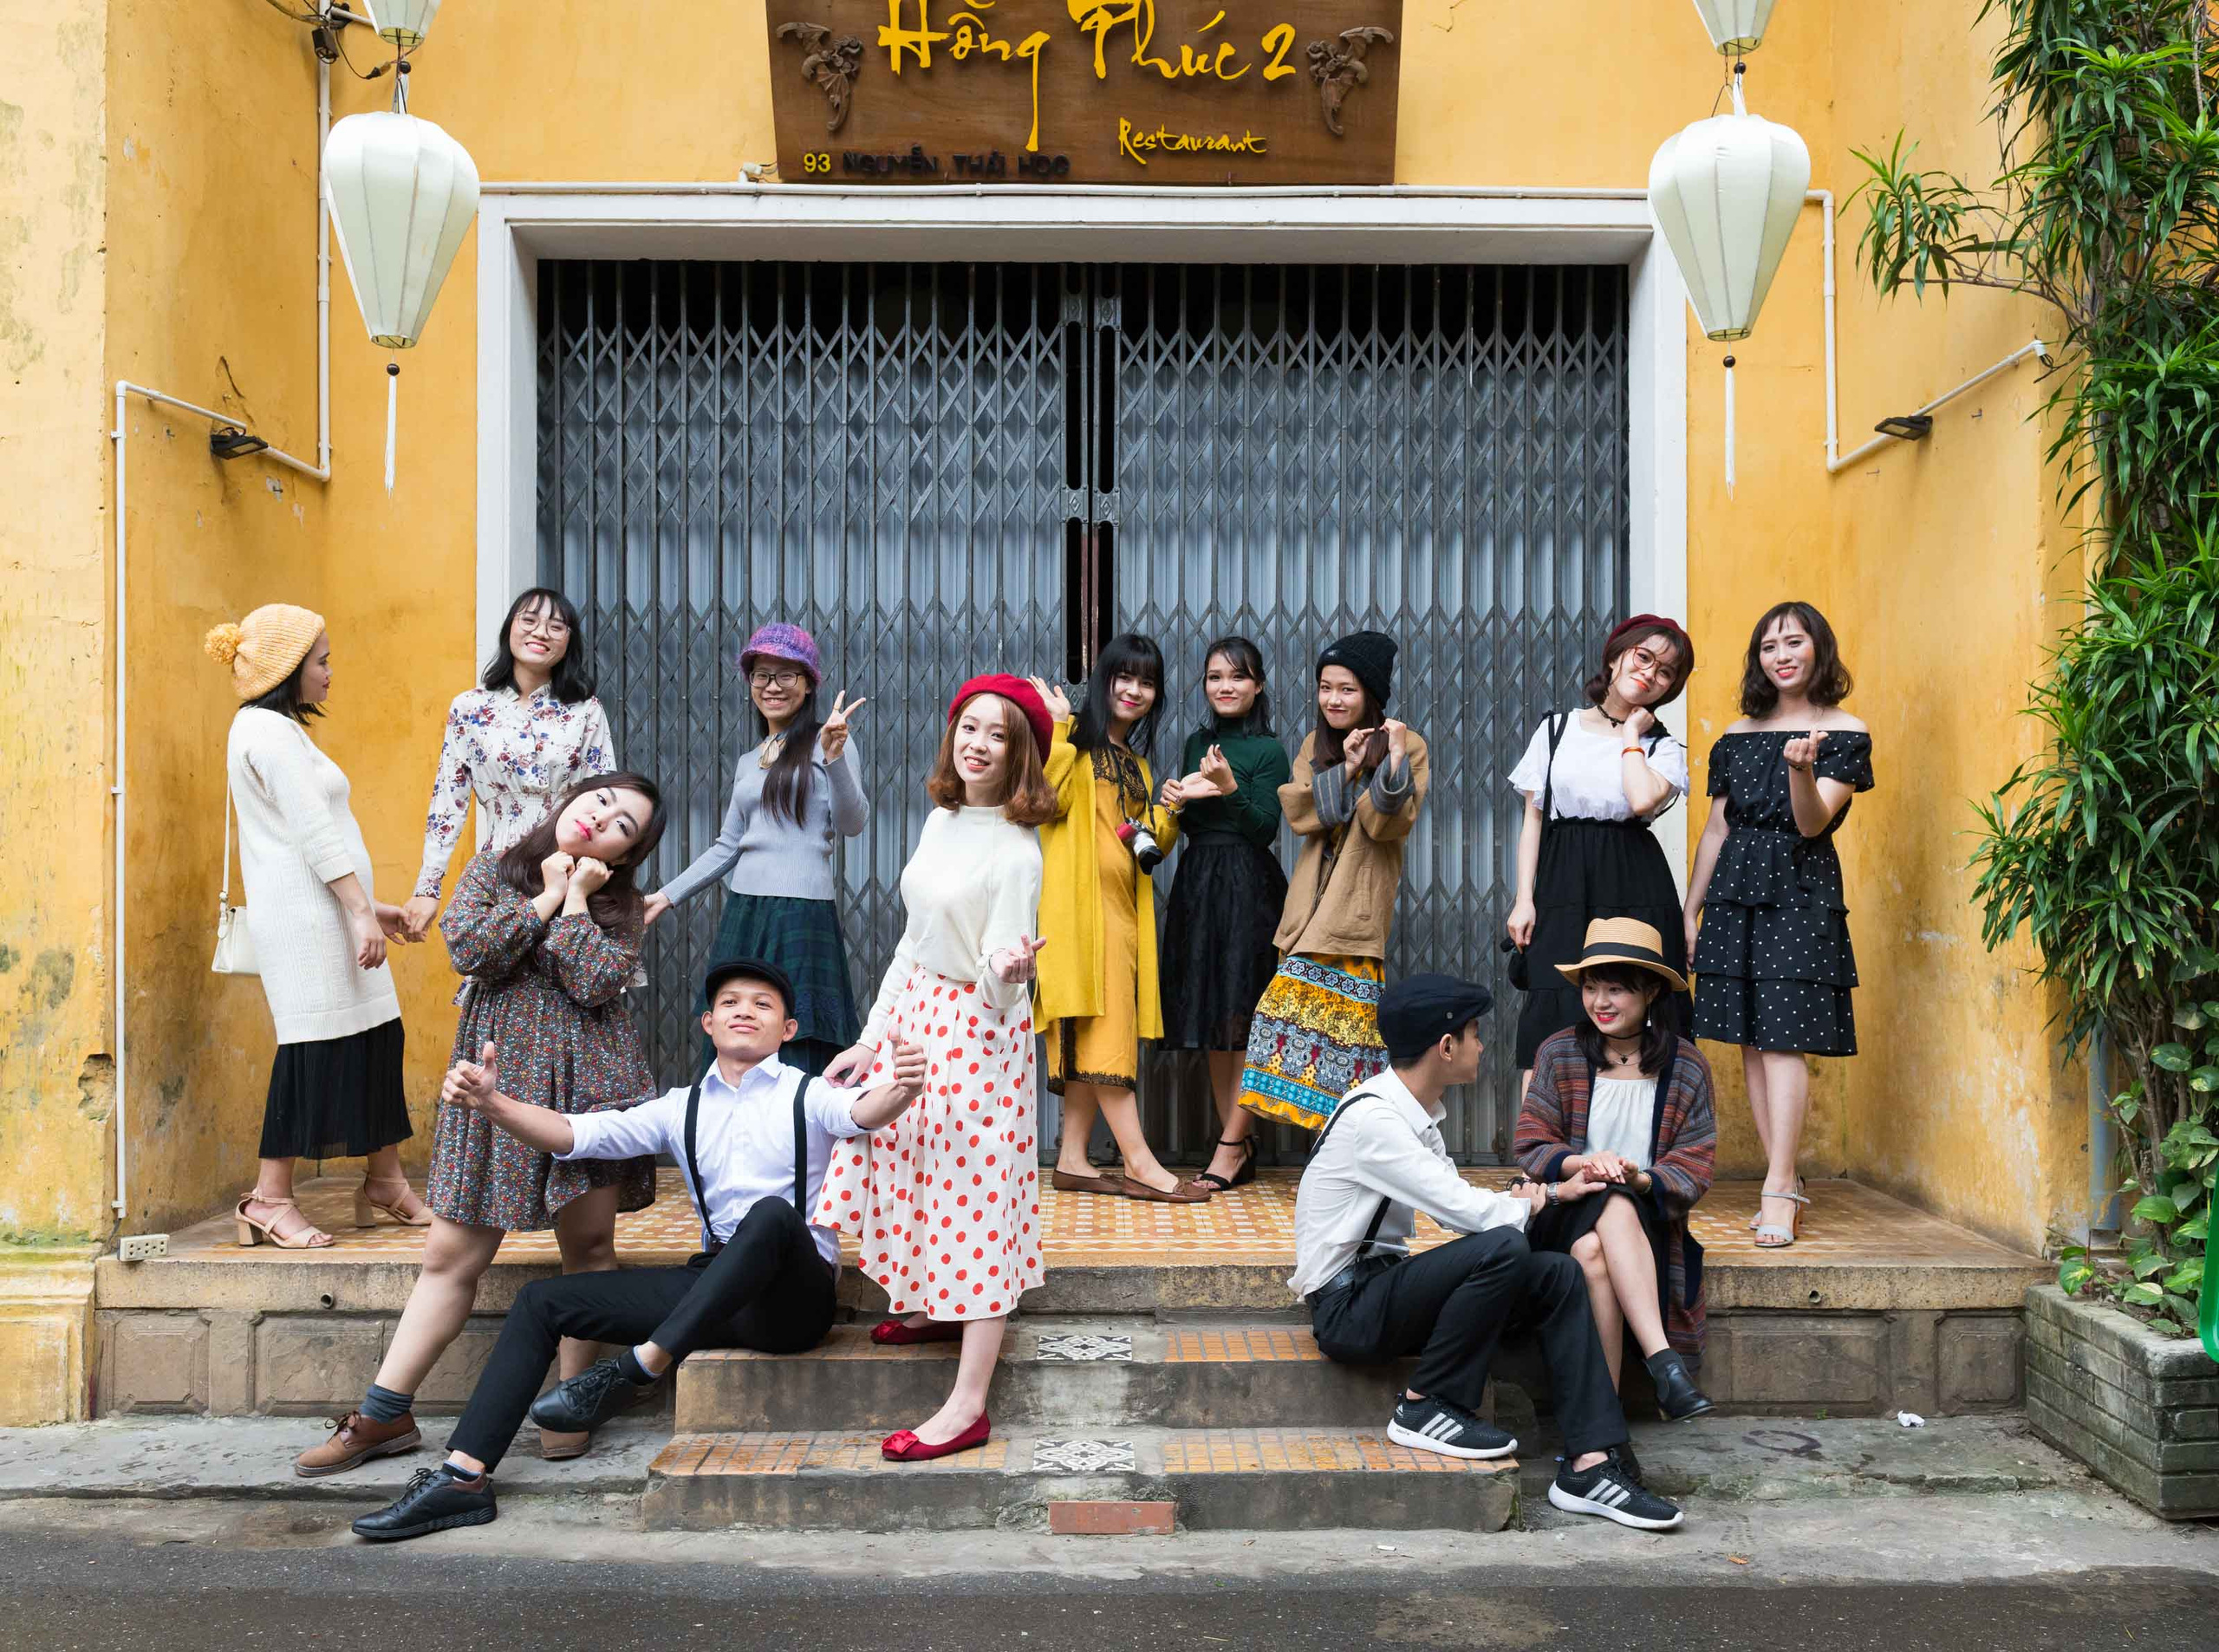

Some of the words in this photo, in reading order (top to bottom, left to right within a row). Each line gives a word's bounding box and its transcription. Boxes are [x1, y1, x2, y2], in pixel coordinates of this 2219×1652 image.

[1261, 23, 1297, 81] 2
[803, 153, 831, 172] 93
[1118, 116, 1266, 165] Restaurant
